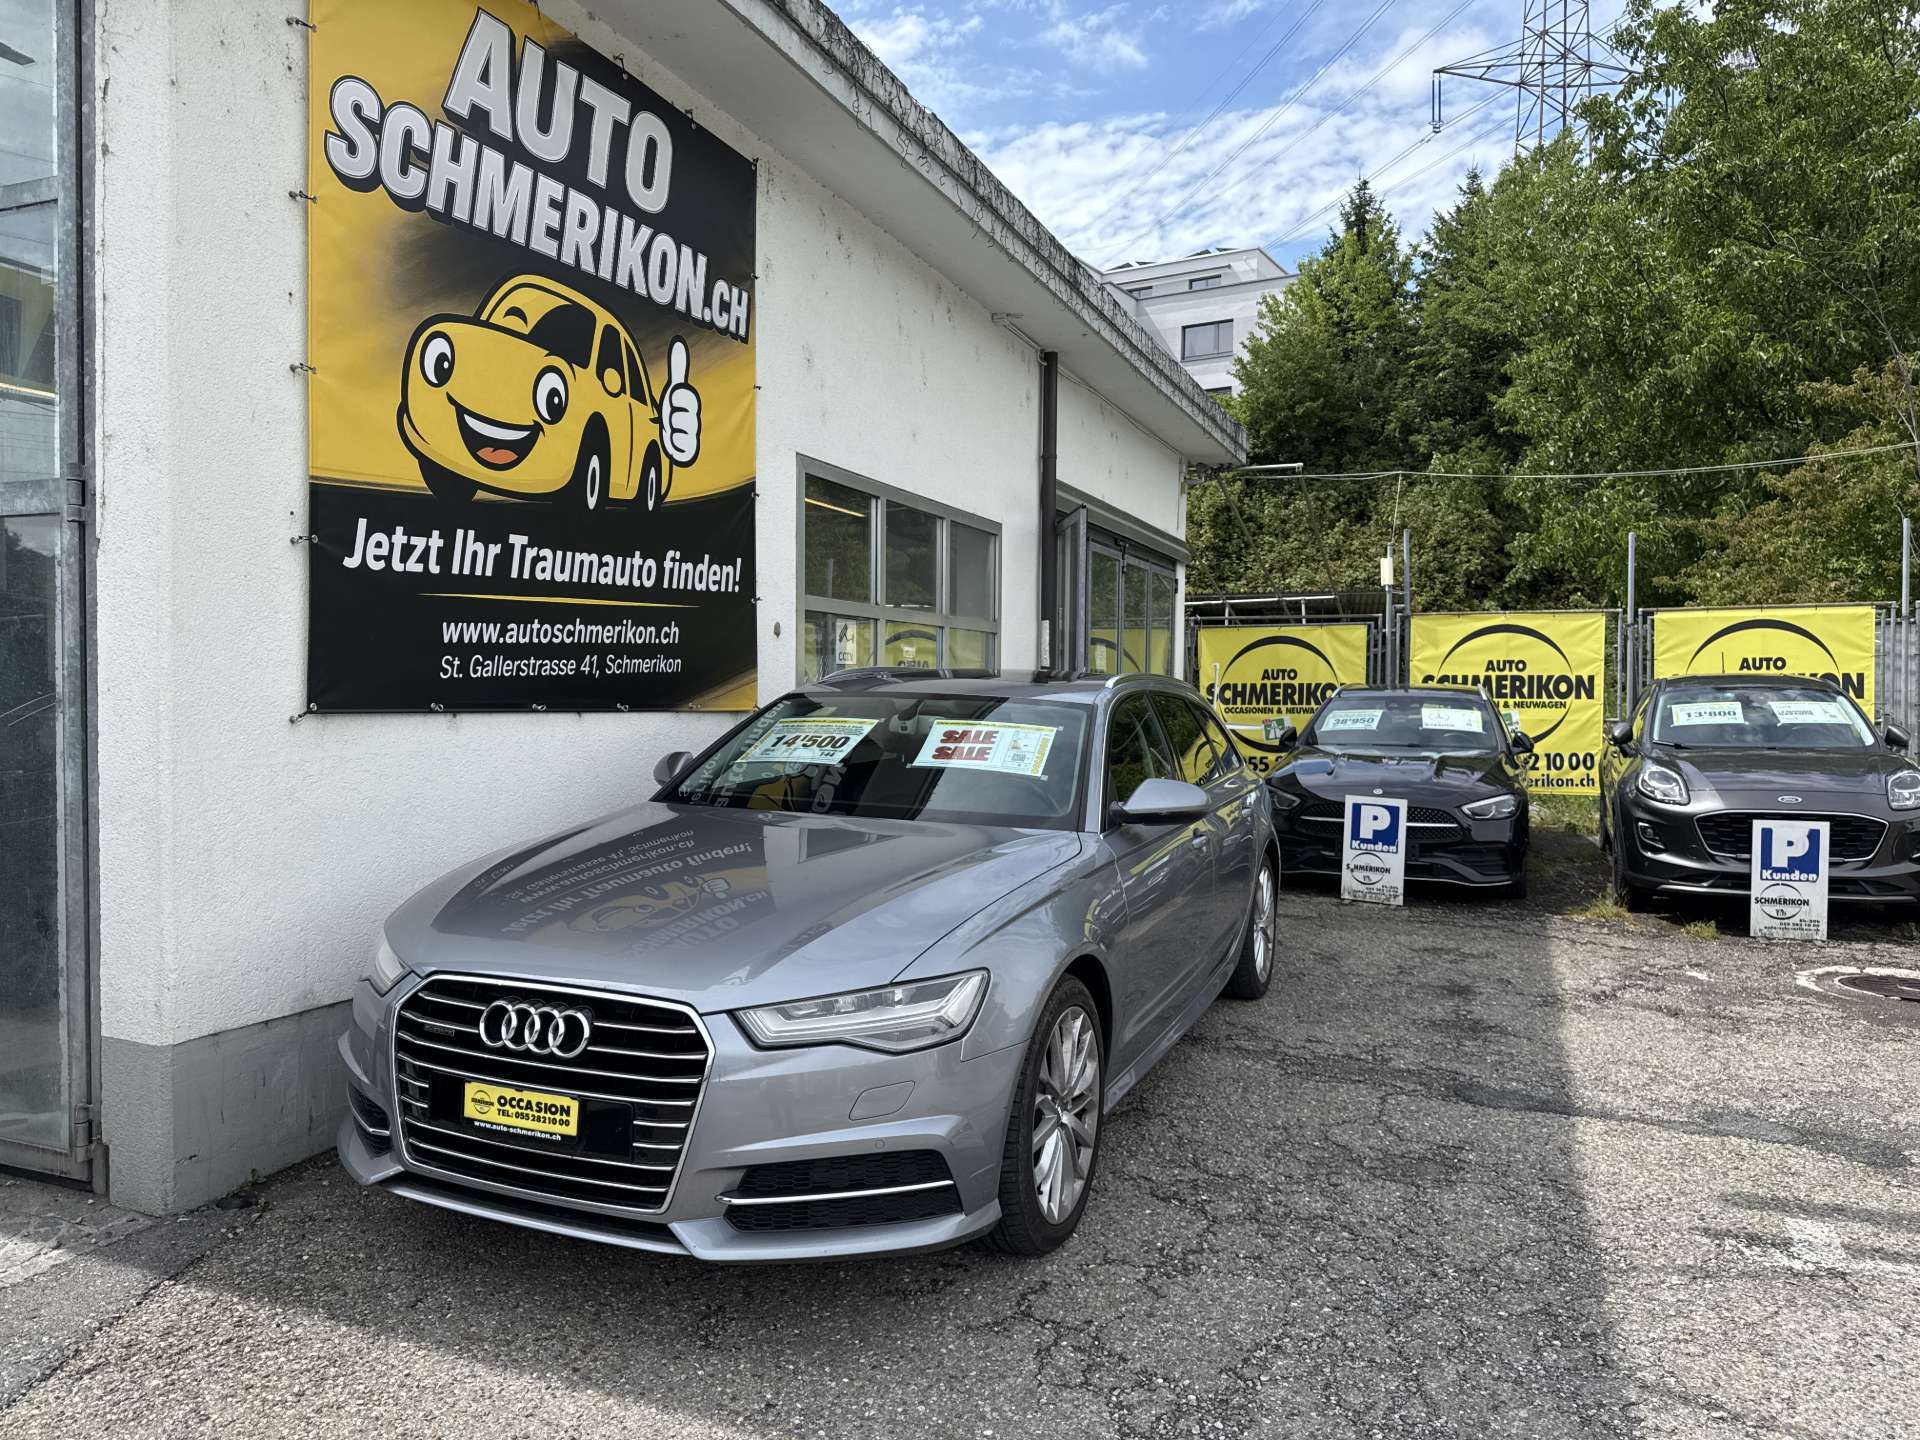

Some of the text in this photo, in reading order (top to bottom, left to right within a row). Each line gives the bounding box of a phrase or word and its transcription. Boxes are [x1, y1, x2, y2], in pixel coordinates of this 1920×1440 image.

[445, 9, 672, 213] AUTO
[327, 77, 748, 342] SCHMERIKON.CH
[343, 517, 741, 593] Jetzt Ihr Traumauto finden!
[442, 618, 680, 645] www.autoschmerikon.ch
[439, 653, 682, 679] St. Gallerstrasse 41, Schmerikon
[1485, 660, 1527, 672] AUTO
[1739, 657, 1786, 671] AUTO
[1261, 668, 1298, 681] AUTO
[1206, 683, 1350, 706] SCHMERIKO
[1224, 706, 1274, 715] OCCASIONEN
[1276, 706, 1283, 714] &
[1514, 701, 1567, 709] NEUWAGEN
[771, 735, 850, 749] 14'500
[940, 730, 999, 744] SALE
[932, 746, 992, 761] SALE
[1247, 756, 1270, 772] 55
[1545, 753, 1564, 771] 10
[1568, 753, 1595, 771] 00
[1360, 805, 1391, 840] P
[1352, 840, 1397, 853] Kunden
[1771, 826, 1810, 868] P
[1762, 869, 1818, 881] Kunden
[1754, 896, 1809, 906] SCHMERIKON
[497, 1095, 571, 1117] OCCASION
[497, 1108, 513, 1118] TEL:
[514, 1111, 529, 1121] 055
[474, 1120, 561, 1140] www.auto-schmerikon.ch
